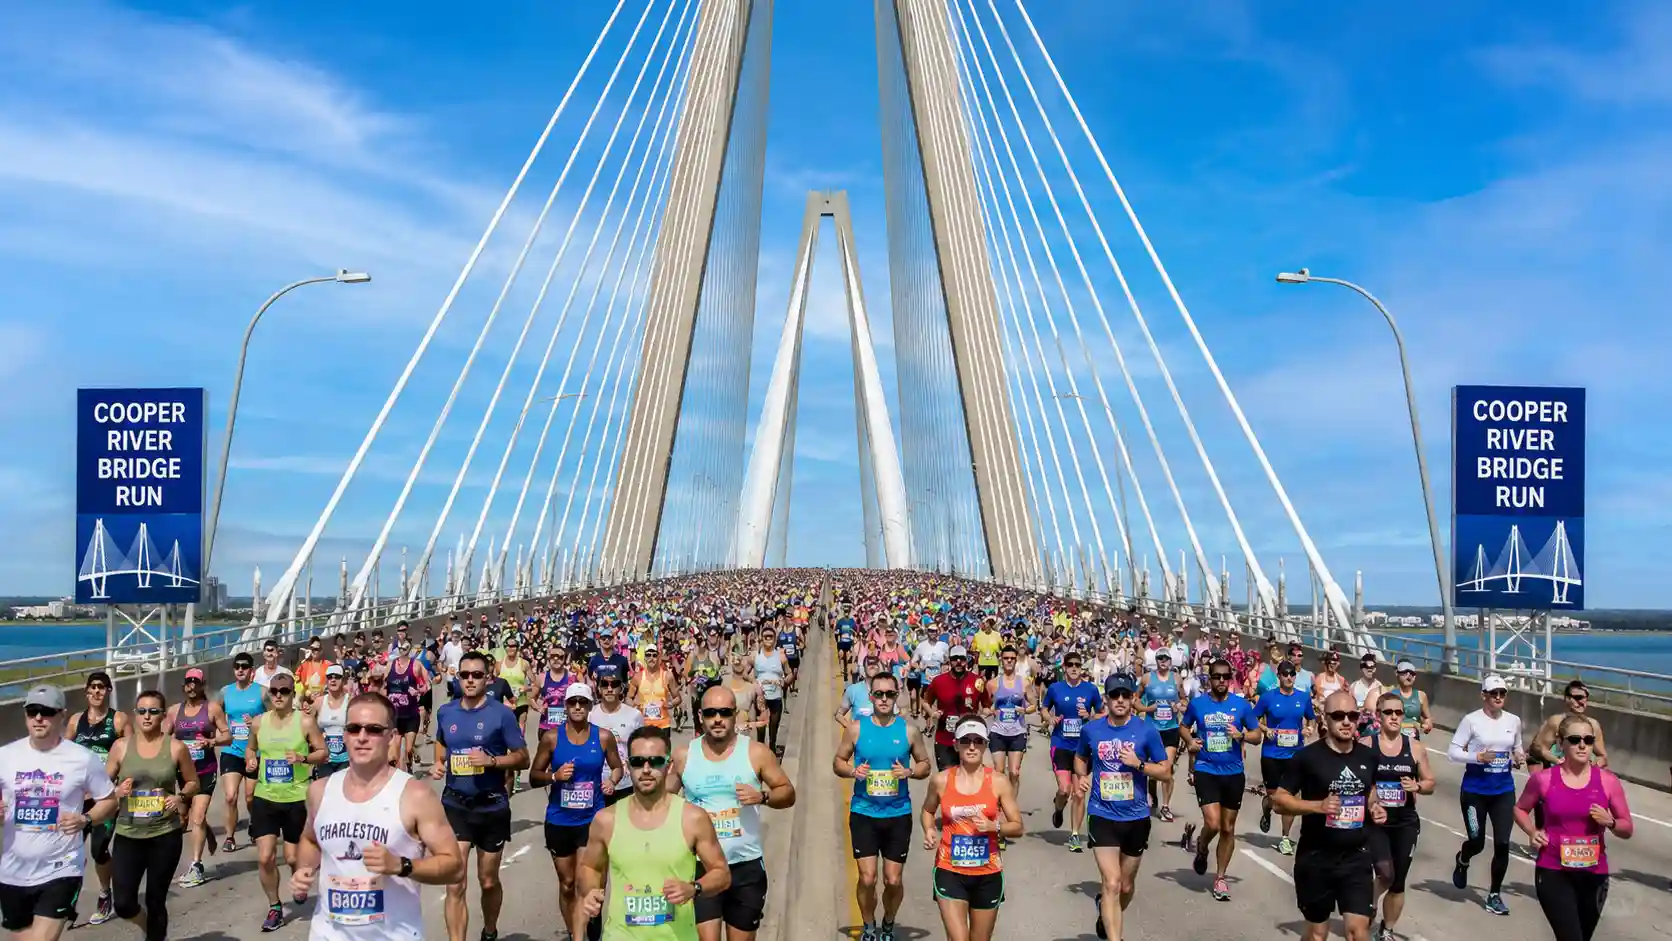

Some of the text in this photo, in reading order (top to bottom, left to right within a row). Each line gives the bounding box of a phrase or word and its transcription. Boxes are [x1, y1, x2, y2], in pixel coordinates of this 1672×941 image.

[94, 402, 185, 423] COOPER
[1473, 399, 1568, 423] COOPER
[107, 430, 172, 451] RIVER
[1487, 428, 1554, 451] RIVER
[98, 457, 181, 479] BRIDGE
[1477, 456, 1564, 480] BRIDGE
[116, 486, 163, 506] RUN
[1496, 486, 1545, 508] RUN
[320, 822, 389, 845] CHARLESTON
